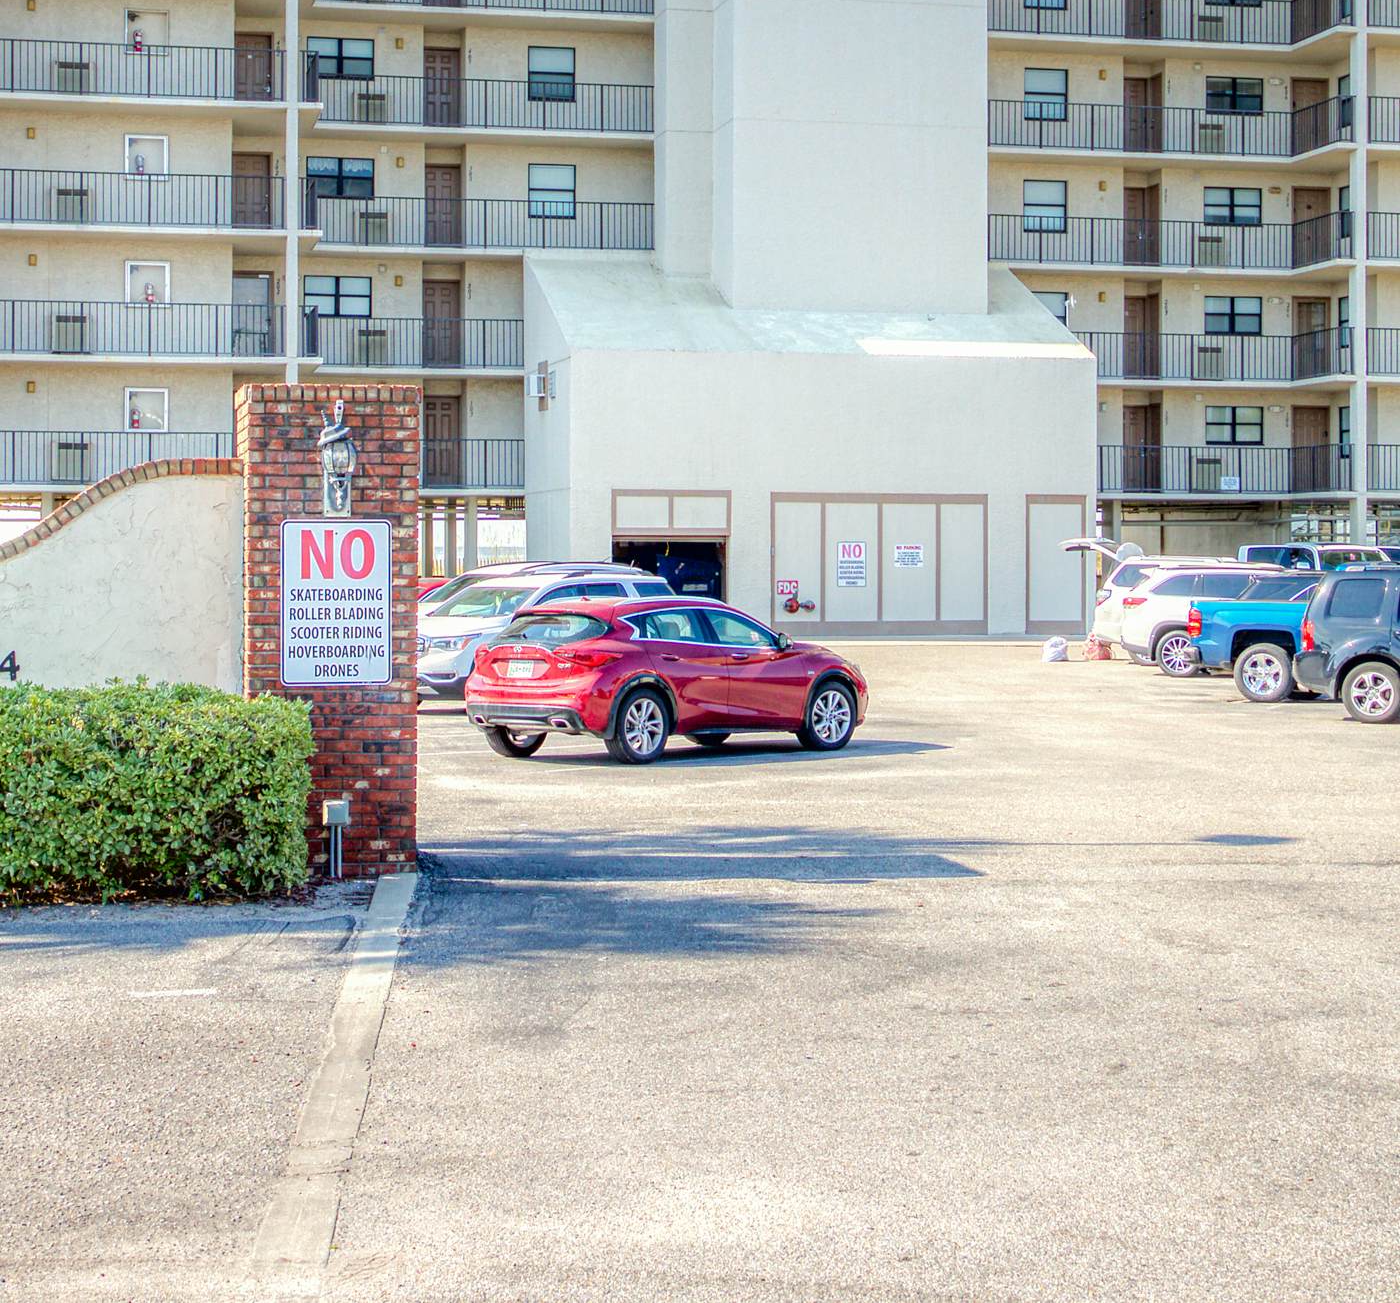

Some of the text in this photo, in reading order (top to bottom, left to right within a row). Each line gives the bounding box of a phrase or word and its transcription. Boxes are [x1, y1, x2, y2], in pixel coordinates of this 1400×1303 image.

[300, 529, 376, 580] NO
[842, 544, 863, 558] NO
[778, 581, 798, 594] FDC
[290, 588, 383, 602] SKATEBOARDING
[289, 607, 384, 621] ROLLER BLADING
[290, 626, 382, 640] SCOOTER RIDING
[288, 644, 385, 659] HOVERBOARDING
[0, 650, 20, 681] 4
[314, 664, 360, 677] DRONES
